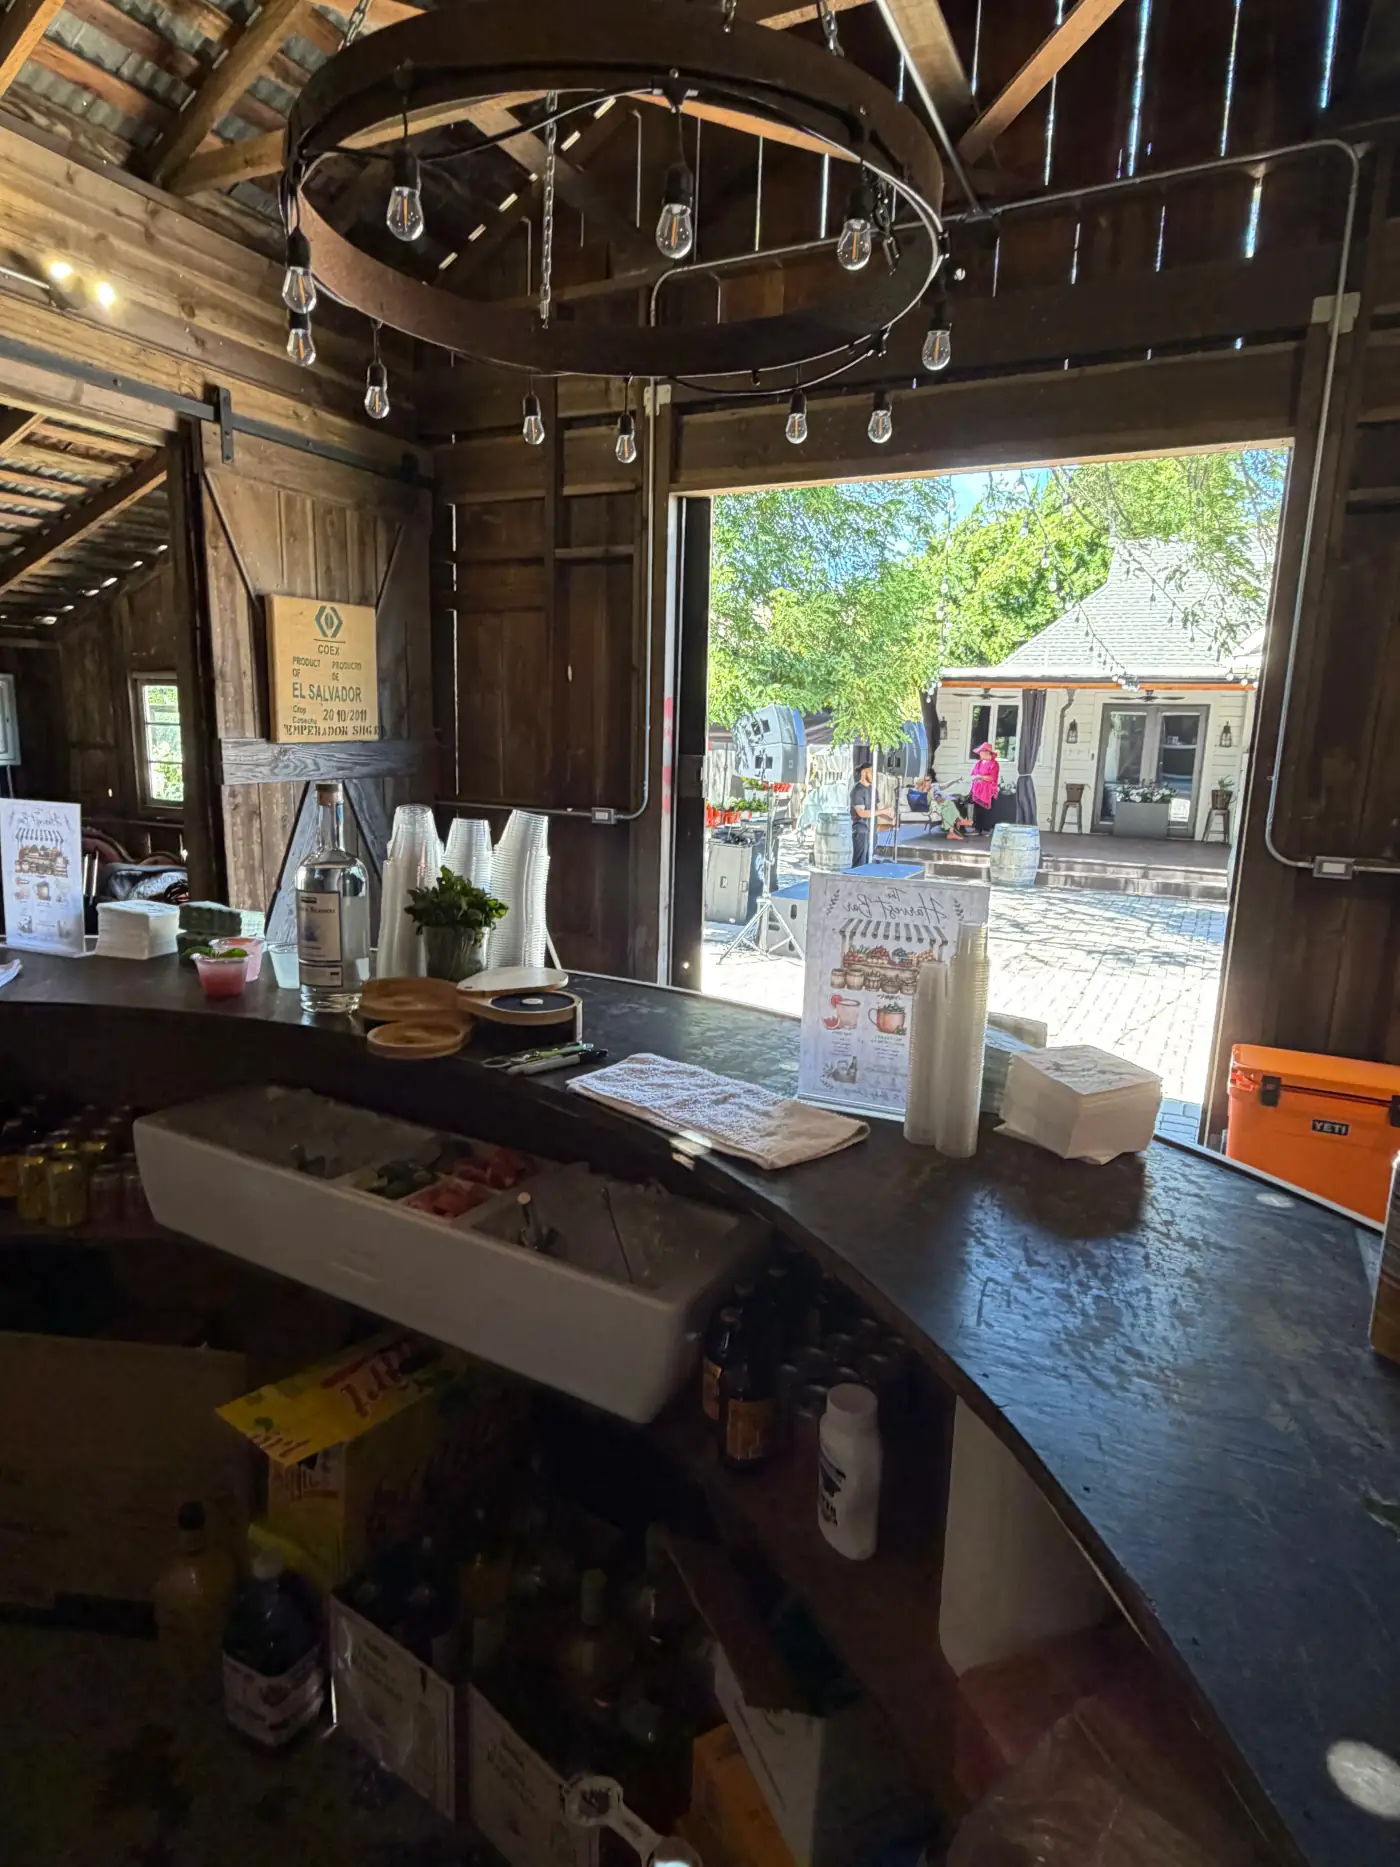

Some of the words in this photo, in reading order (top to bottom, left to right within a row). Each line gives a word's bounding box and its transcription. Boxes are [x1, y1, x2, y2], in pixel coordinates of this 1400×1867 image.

[317, 644, 340, 656] COEX
[292, 656, 320, 668] PRODUCT
[332, 661, 362, 671] PRODUCTO
[292, 668, 300, 677] OF
[332, 672, 340, 681] DE
[292, 682, 306, 699] EL
[308, 684, 362, 702] SALVADOR
[1314, 1121, 1347, 1133] YETI
